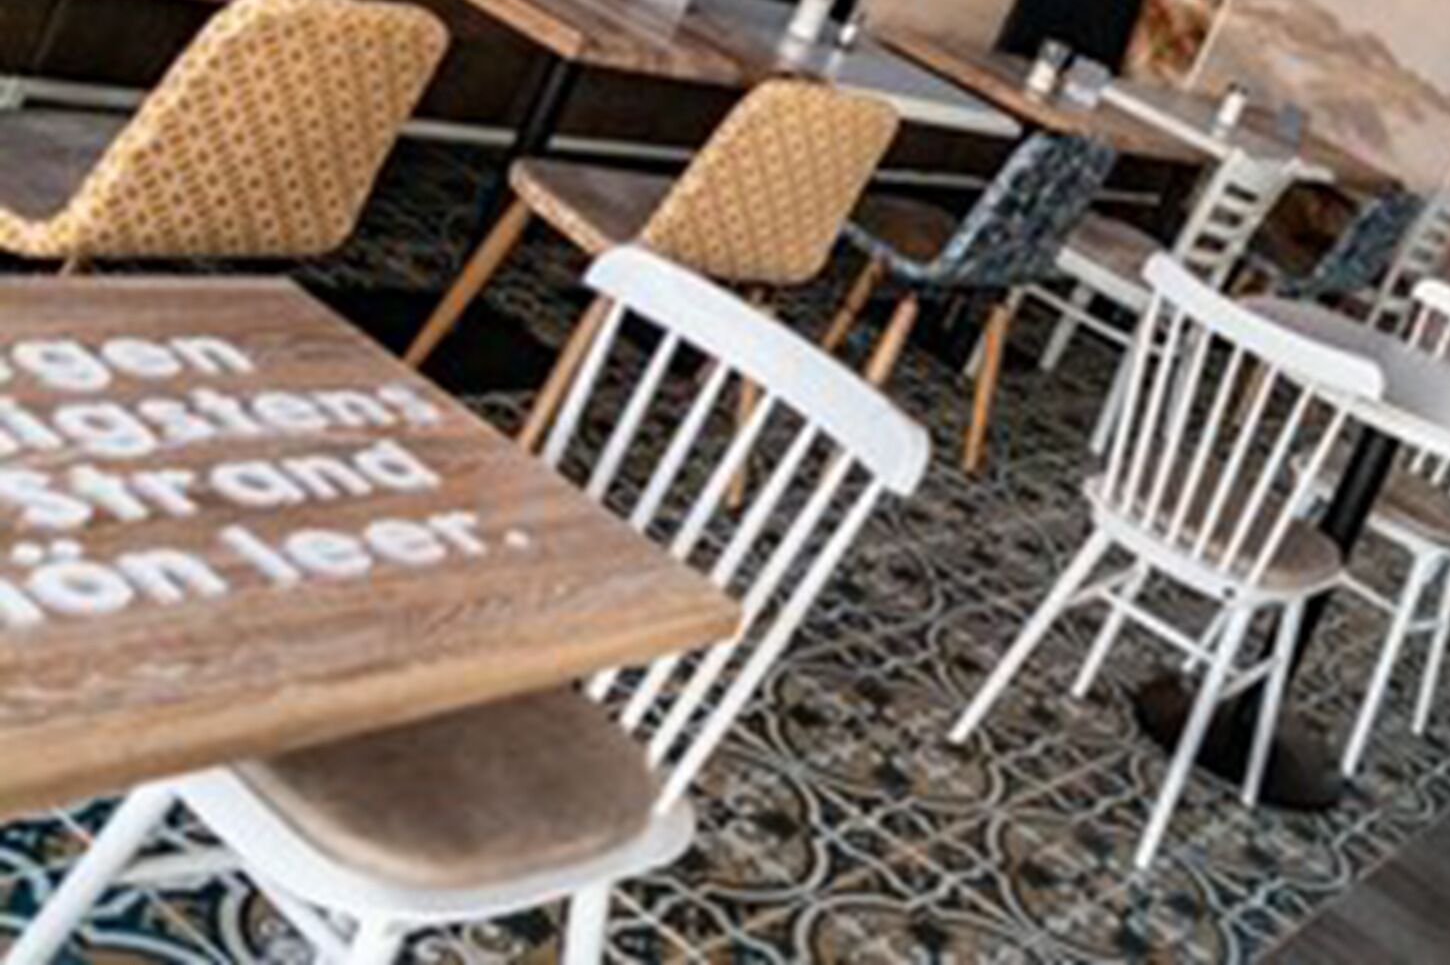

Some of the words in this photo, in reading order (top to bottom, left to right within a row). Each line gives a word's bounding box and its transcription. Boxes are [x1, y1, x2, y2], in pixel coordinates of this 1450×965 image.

[0, 336, 255, 392] gen
[0, 380, 441, 458] igstens
[0, 438, 441, 530] Strand
